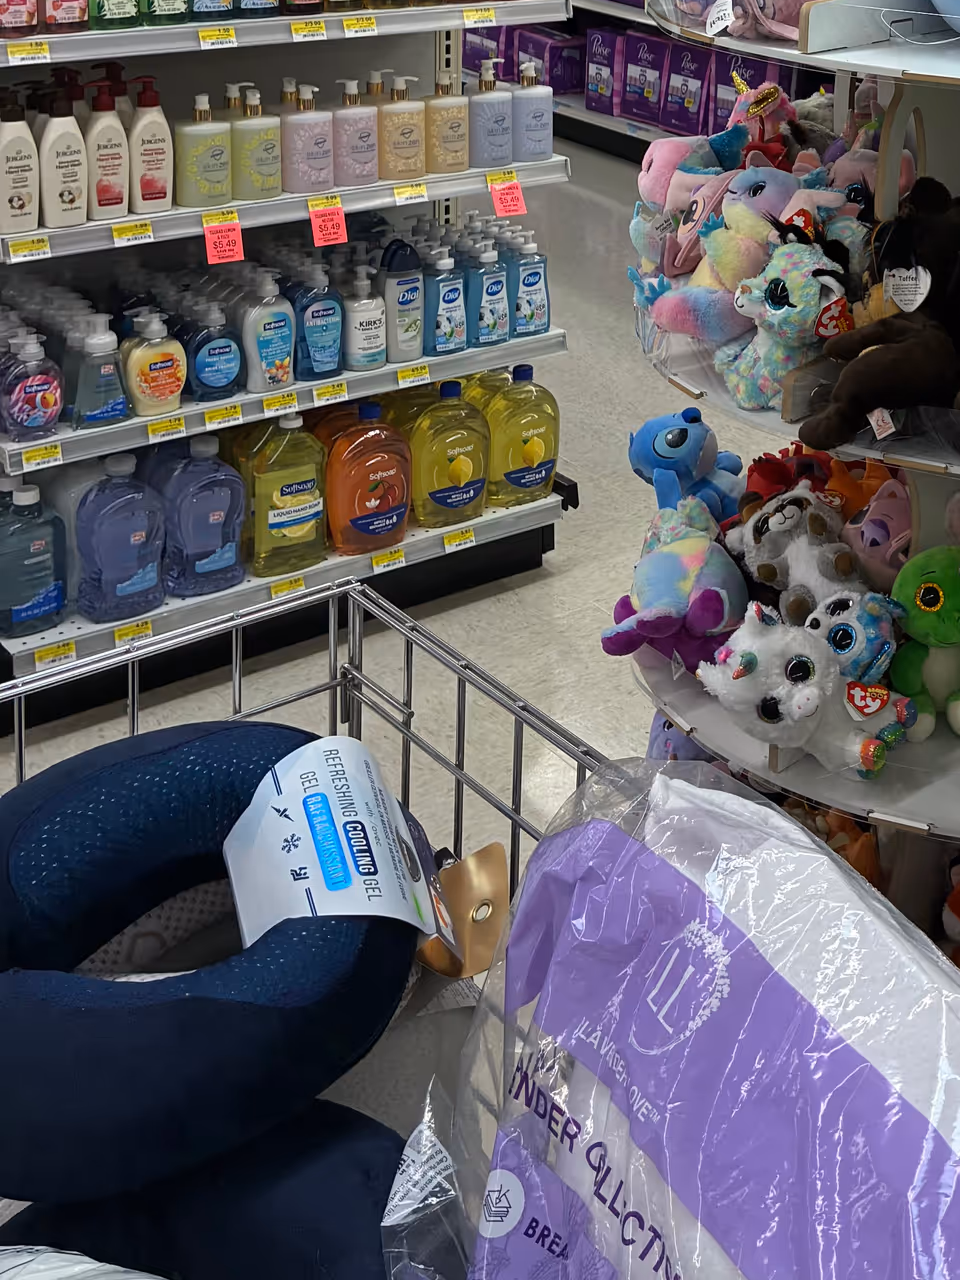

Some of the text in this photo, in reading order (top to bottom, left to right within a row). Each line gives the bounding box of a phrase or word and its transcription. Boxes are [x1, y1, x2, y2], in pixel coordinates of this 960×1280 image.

[591, 34, 611, 56] Poise
[637, 42, 655, 61] Poise
[681, 51, 698, 70] Poise
[727, 55, 755, 80] Poise
[96, 142, 123, 152] JERGENS
[140, 136, 167, 147] JERGENS
[5, 154, 33, 164] JERGENS
[56, 149, 82, 159] JERGENS
[499, 196, 520, 204] $5.49
[318, 223, 341, 233] $5.49
[213, 239, 237, 249] $5.49
[524, 274, 540, 284] Dial
[487, 283, 503, 293] Dial
[399, 287, 419, 302] Dial
[444, 291, 460, 301] Dial
[313, 308, 334, 317] Softsoap
[265, 320, 286, 330] Softsoap
[818, 304, 842, 336] ty
[209, 347, 231, 355] Softsoap
[150, 361, 173, 369] Softsoap
[25, 384, 50, 392] Softsoap
[522, 426, 546, 437] Softsoap
[447, 444, 474, 456] Softsoap
[369, 467, 397, 481] Softsoap
[282, 480, 315, 494] Softsoap
[273, 501, 321, 518] LIQUID HAND SOAP
[850, 687, 881, 714] ty
[300, 771, 320, 794] GEL
[365, 801, 374, 817] with
[323, 748, 382, 902] REFRESHING COOLING GEL
[523, 1217, 569, 1260] BREA
